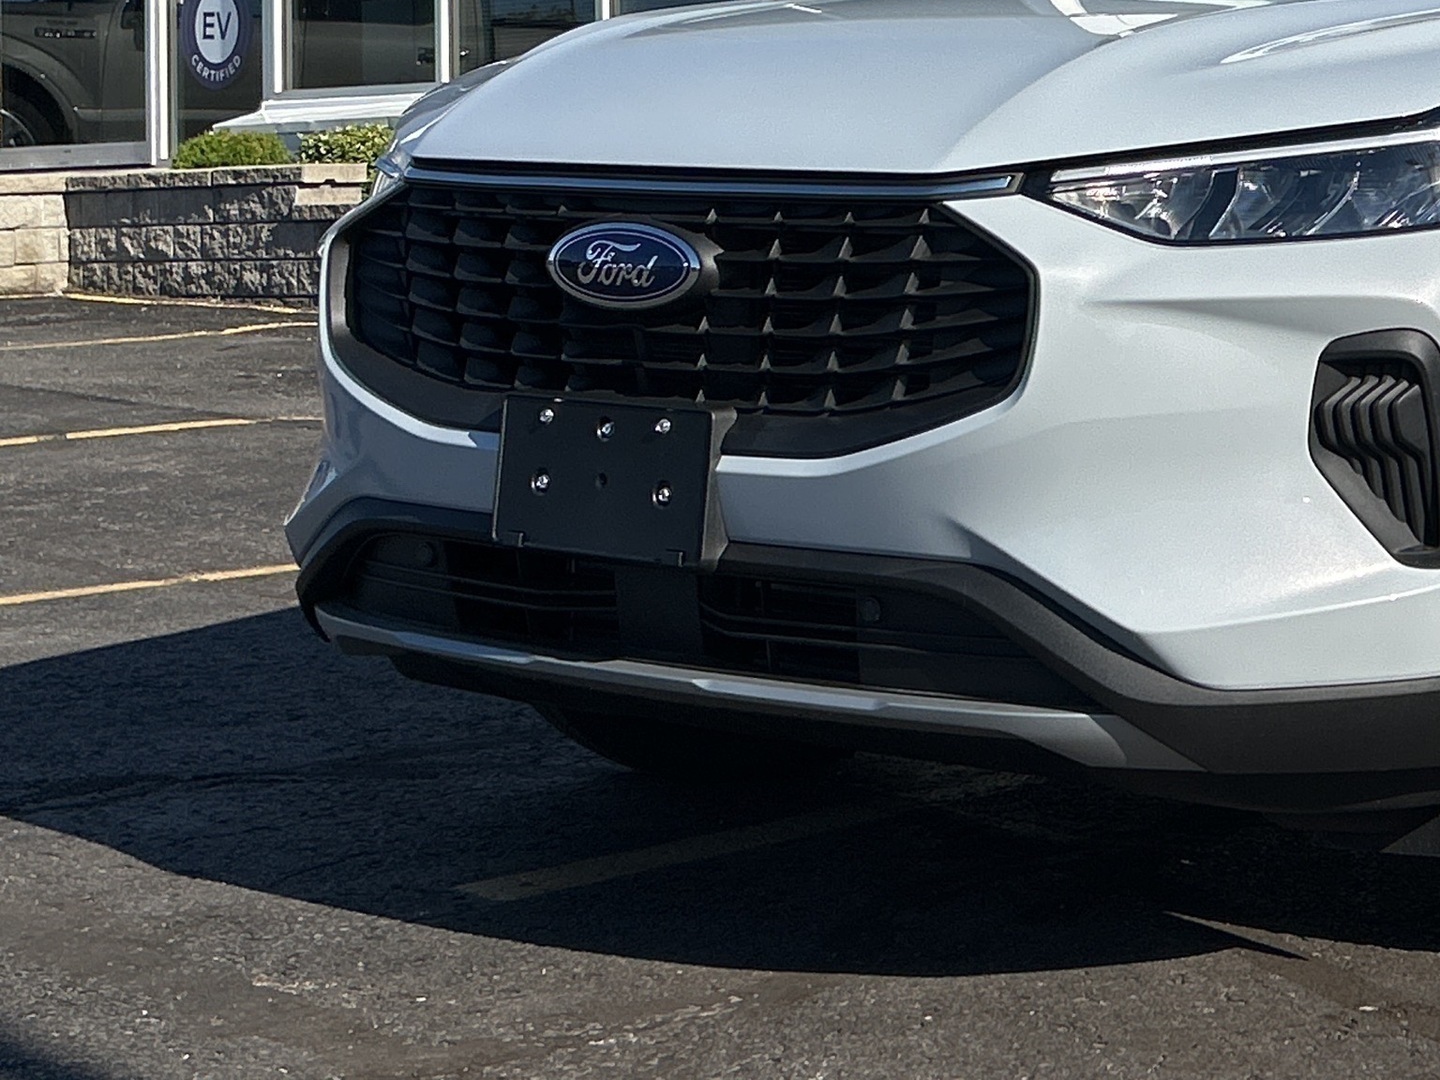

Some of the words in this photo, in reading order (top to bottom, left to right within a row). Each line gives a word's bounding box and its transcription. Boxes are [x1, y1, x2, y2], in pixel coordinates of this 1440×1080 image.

[202, 11, 232, 40] EV
[191, 54, 242, 82] CERTIFIED
[577, 239, 658, 287] Ford
